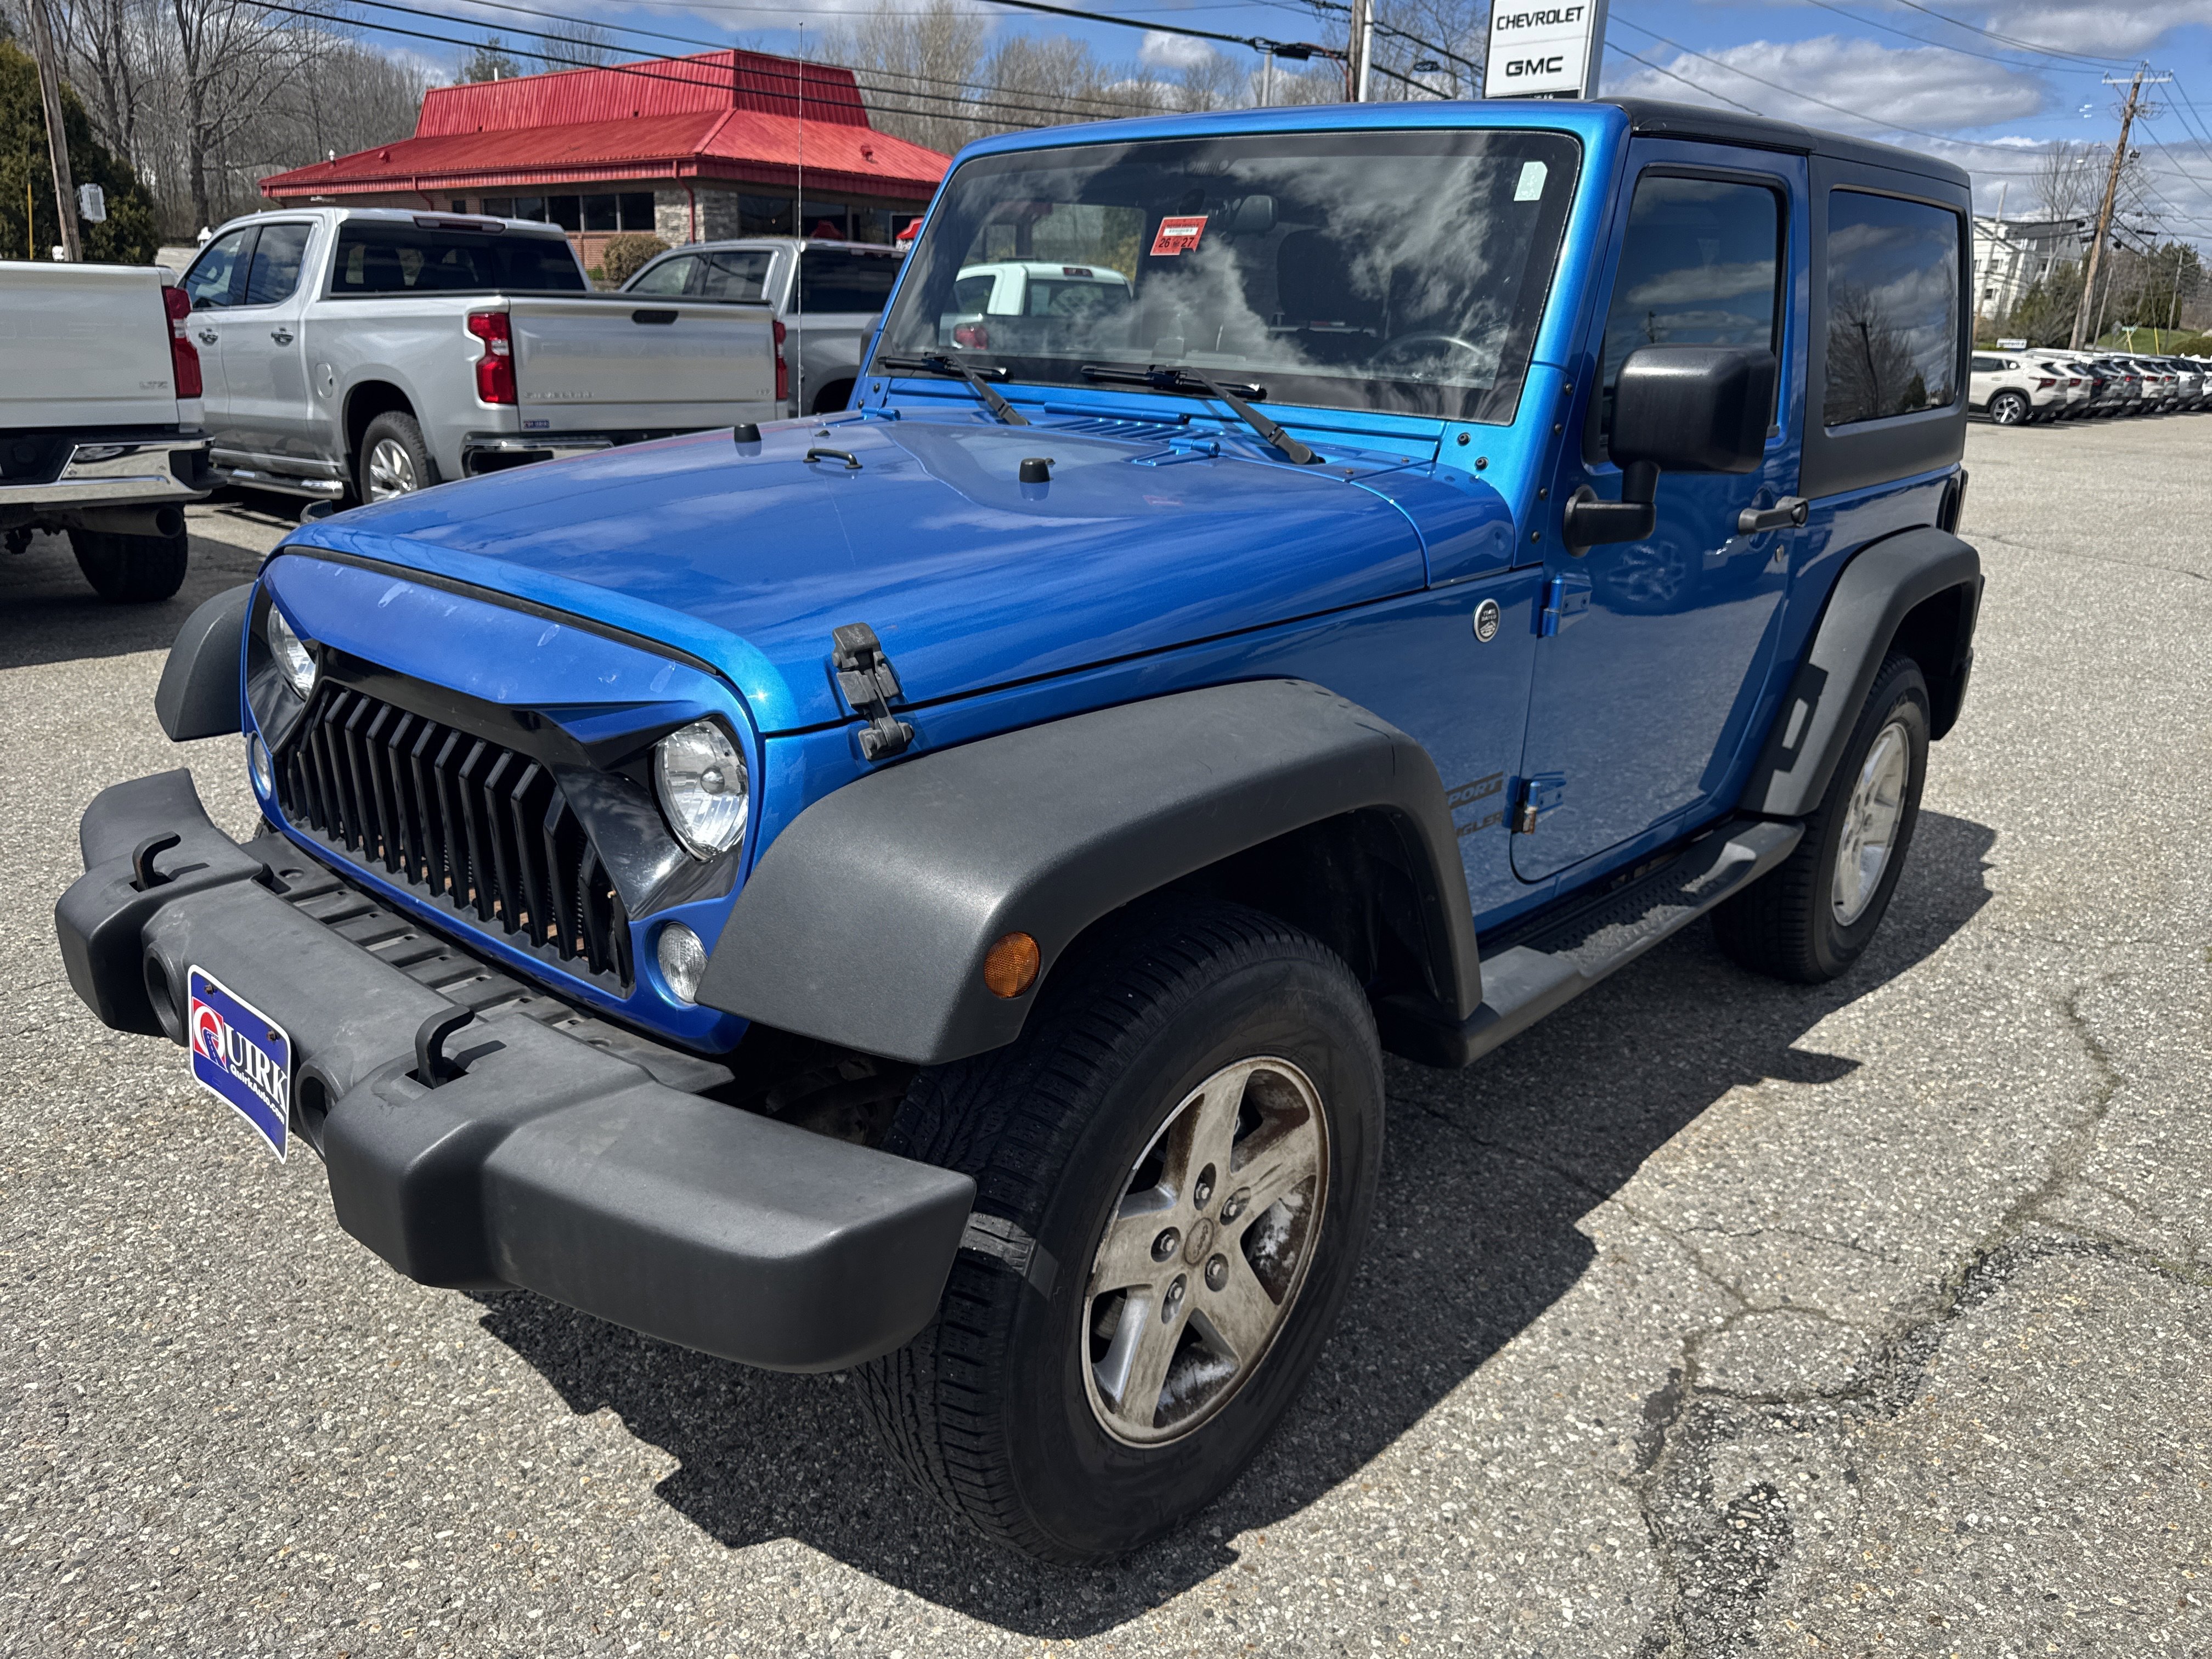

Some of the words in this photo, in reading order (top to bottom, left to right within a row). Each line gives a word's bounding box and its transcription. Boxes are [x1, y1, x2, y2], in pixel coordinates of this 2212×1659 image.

[1497, 6, 1584, 31] CHEVROLET
[1506, 56, 1564, 77] GMC
[1159, 238, 1171, 248] 26
[1181, 237, 1195, 247] 27
[230, 1063, 285, 1125] QuirkAuto.com
